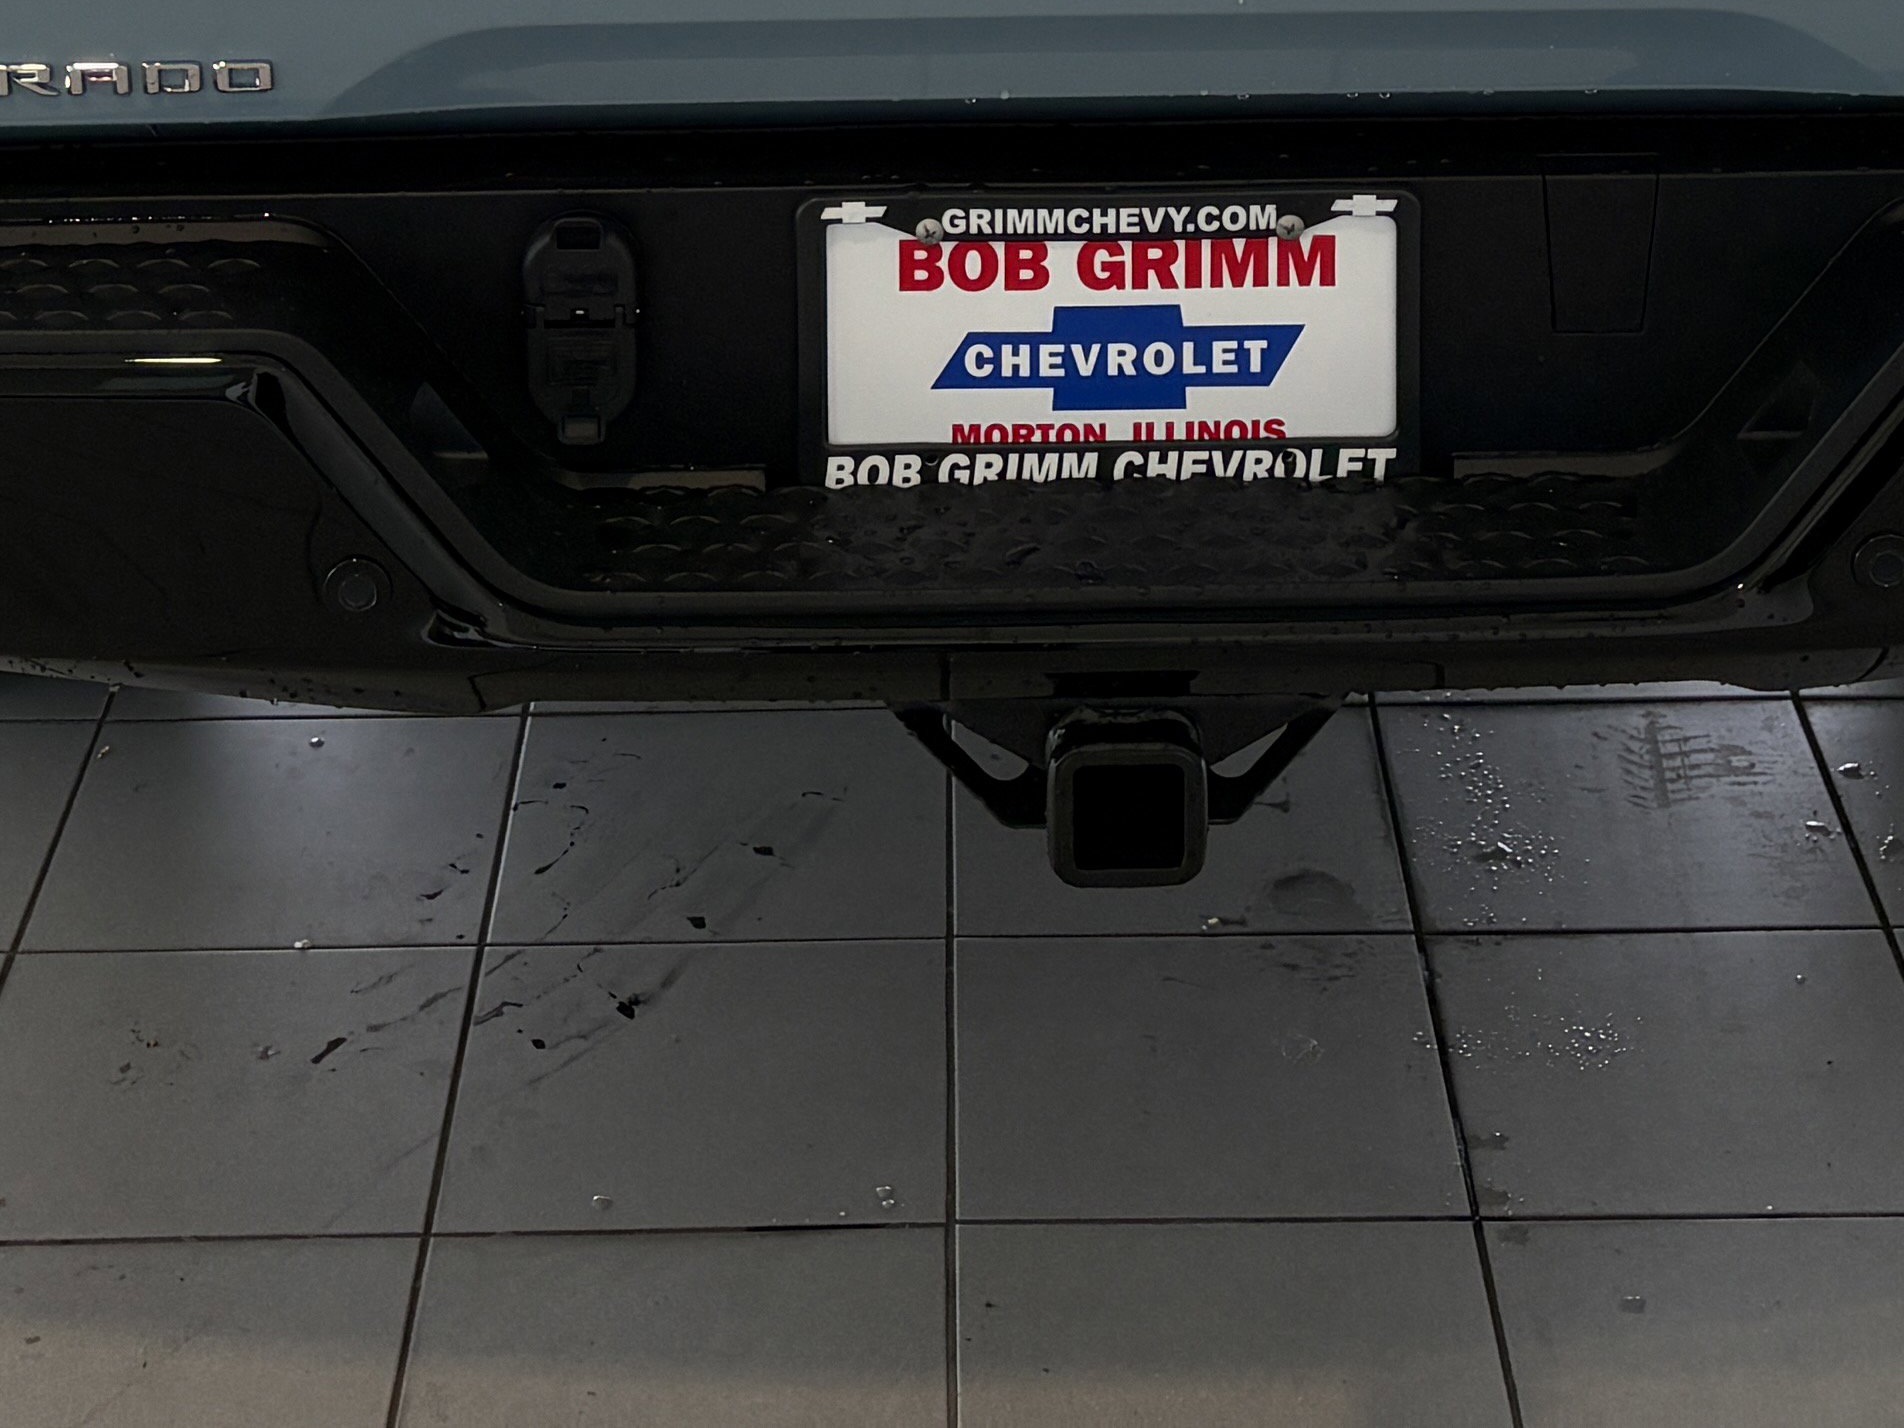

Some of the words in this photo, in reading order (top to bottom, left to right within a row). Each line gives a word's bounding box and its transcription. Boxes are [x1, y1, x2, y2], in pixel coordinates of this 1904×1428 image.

[941, 204, 1278, 235] GRIMMCHEVY.COM
[898, 238, 1051, 293] BOB
[1076, 234, 1337, 292] GRIMM
[963, 339, 1269, 378] CHEVROLET
[824, 454, 923, 489] BOB
[938, 451, 1100, 486] GRIMM
[1112, 447, 1398, 484] CHEVROLET
